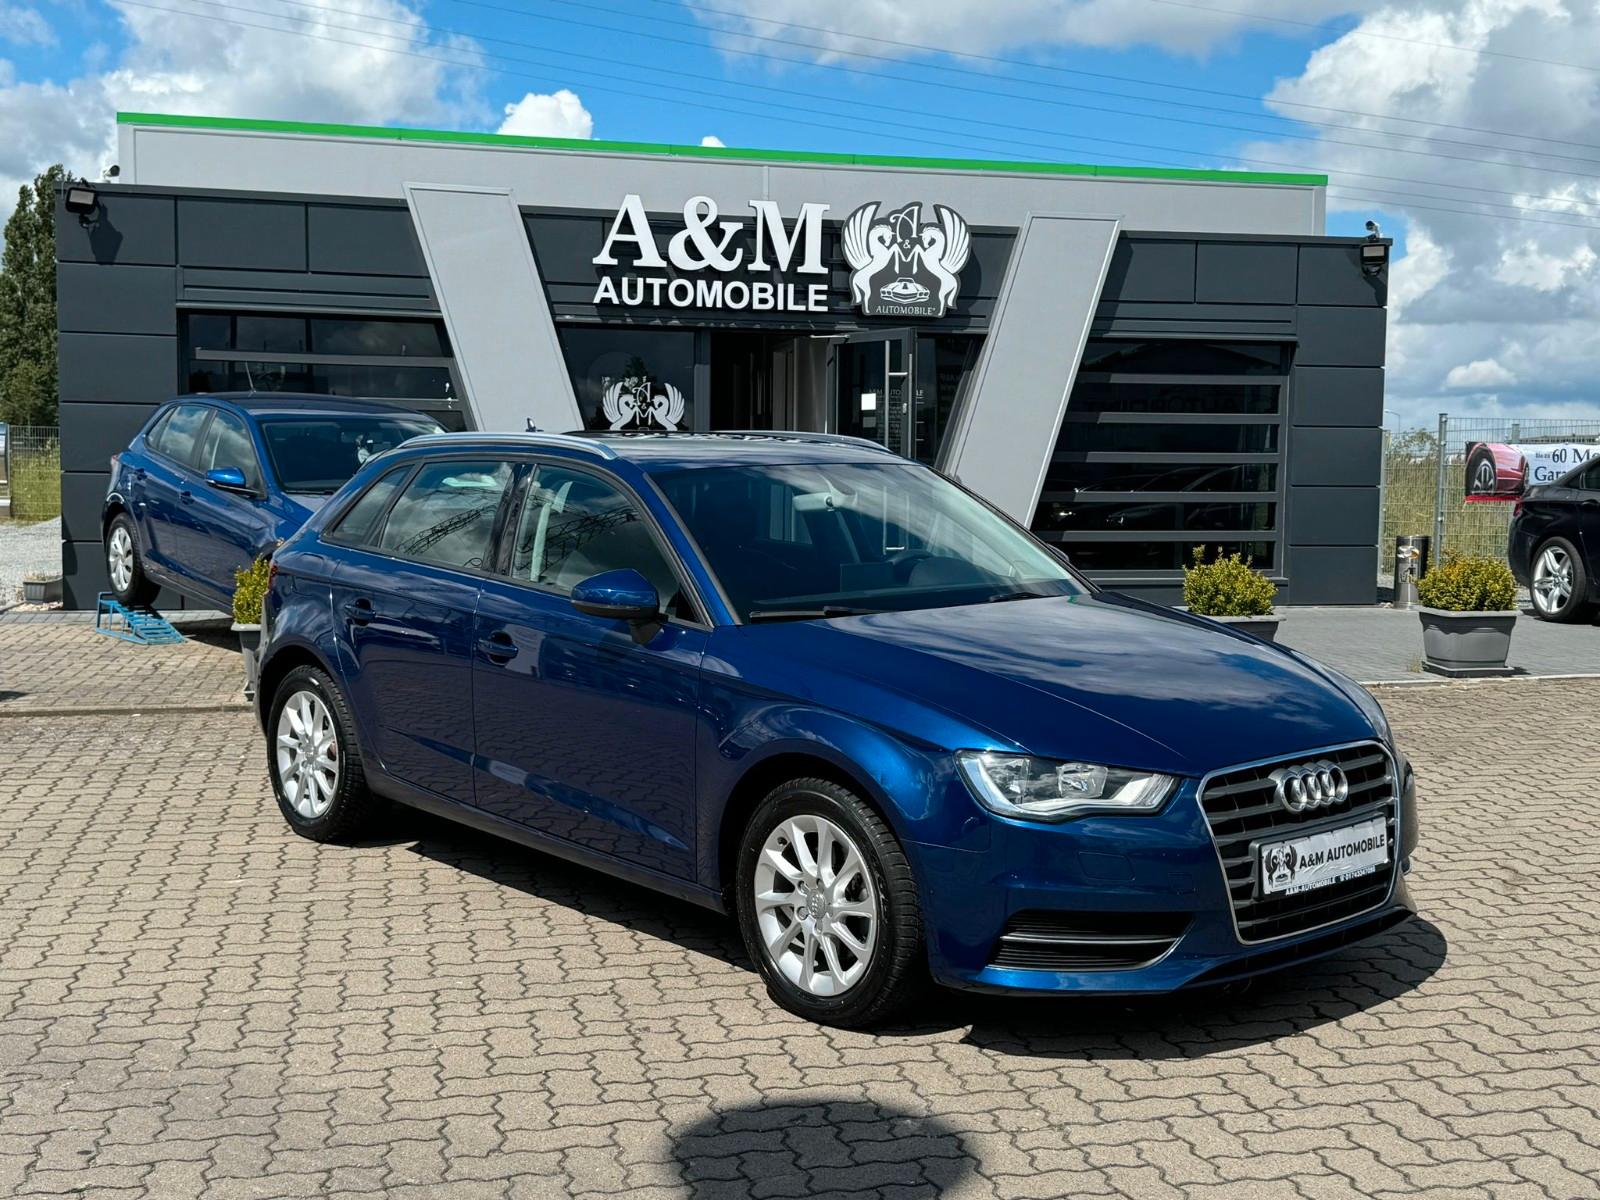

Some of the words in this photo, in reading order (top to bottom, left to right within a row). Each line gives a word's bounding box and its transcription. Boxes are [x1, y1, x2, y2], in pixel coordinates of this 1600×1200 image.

[592, 194, 831, 275] A&M
[593, 276, 829, 312] AUTOMOBILE
[1552, 448, 1567, 463] 60
[1299, 852, 1324, 869] A&M
[1326, 834, 1385, 862] AUTOMOBILE
